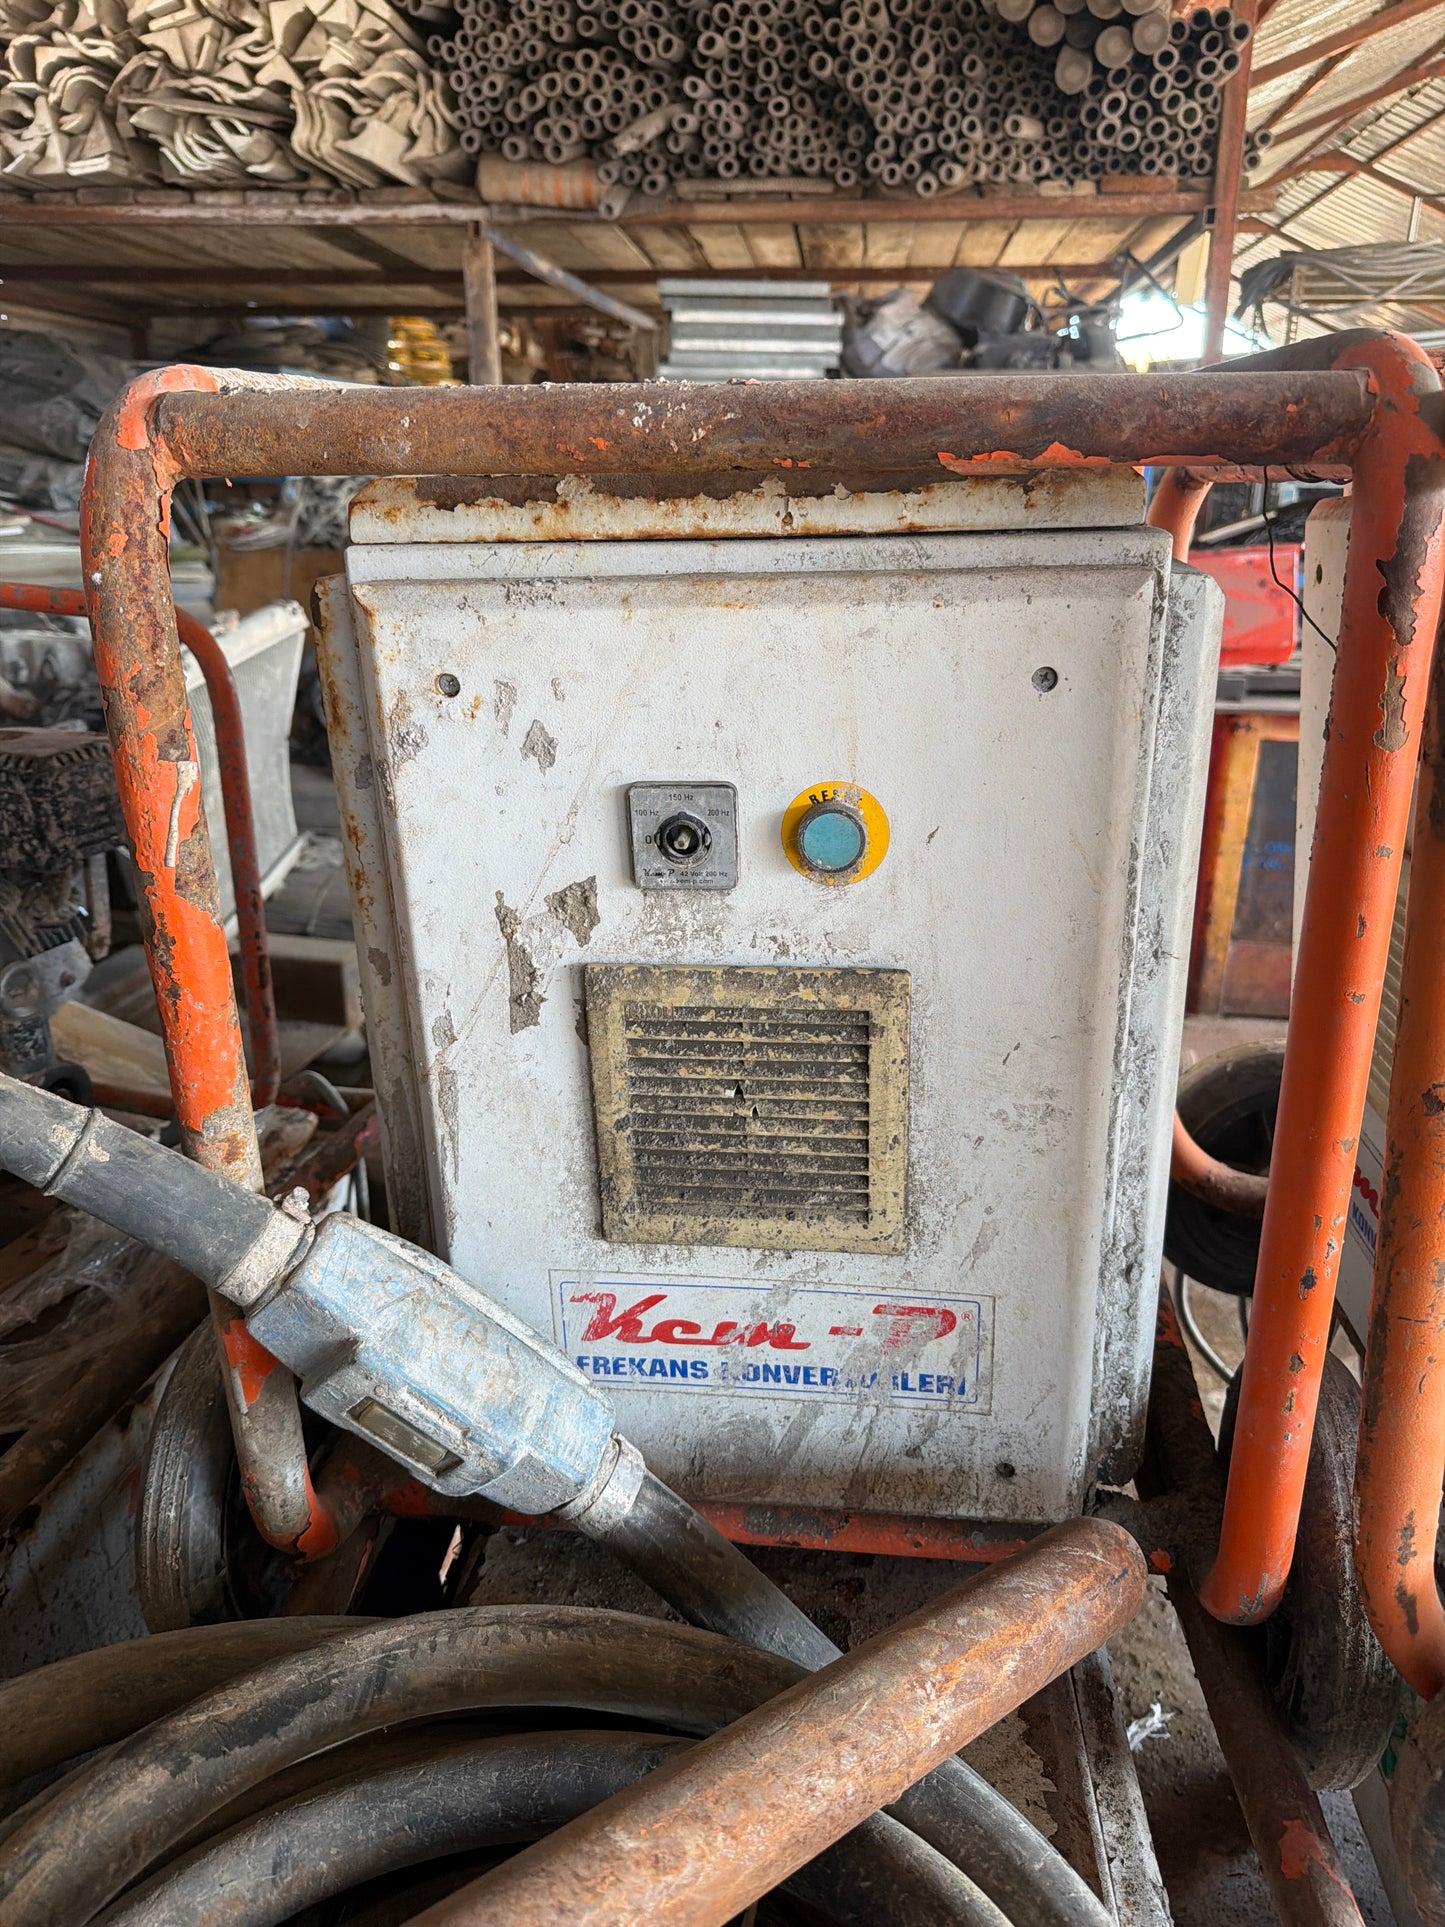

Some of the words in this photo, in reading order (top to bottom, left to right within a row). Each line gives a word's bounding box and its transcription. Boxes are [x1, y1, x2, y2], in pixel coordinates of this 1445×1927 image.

[669, 793, 682, 801] 150
[684, 793, 694, 801] Hz
[635, 809, 648, 817] 100
[649, 809, 660, 817] Hz
[707, 809, 719, 817] 200
[721, 809, 730, 817] Hz
[576, 1355, 709, 1380] FREKANS
